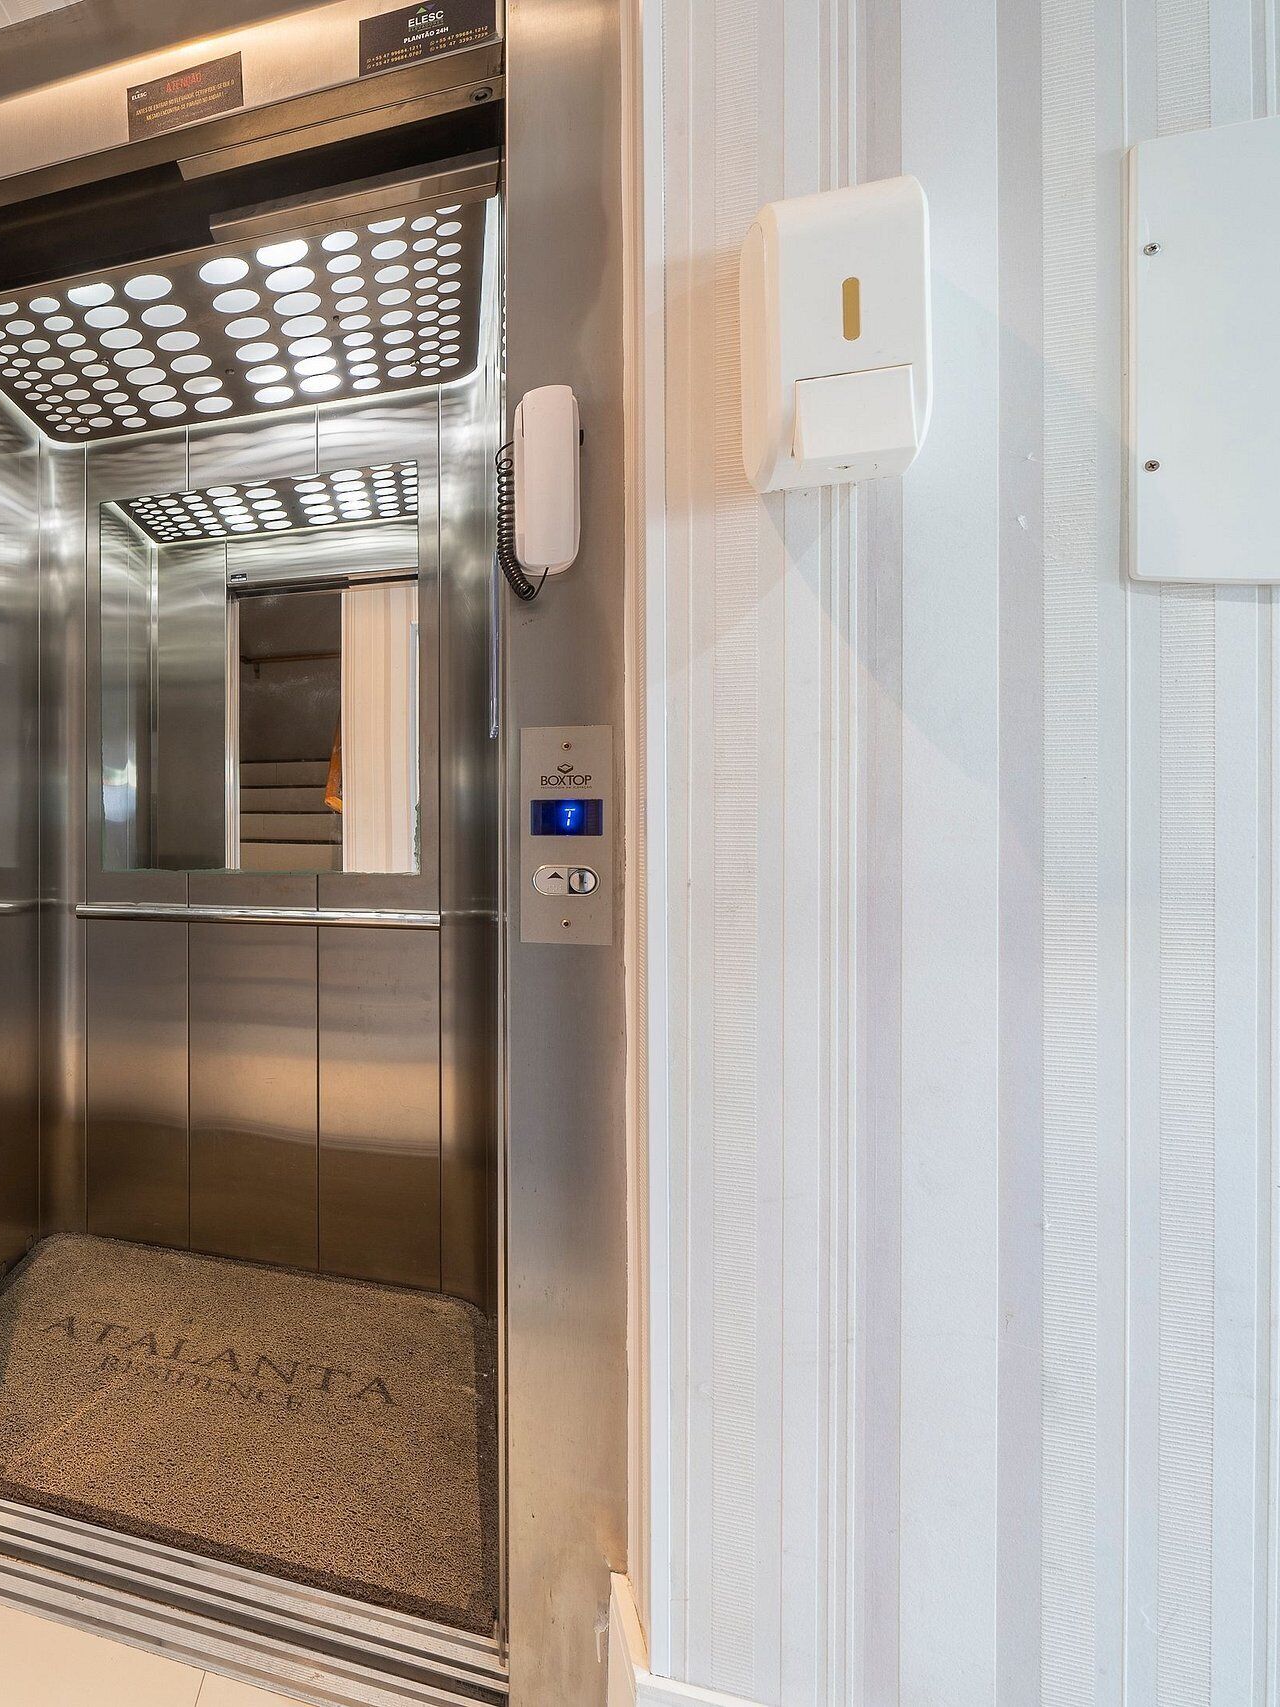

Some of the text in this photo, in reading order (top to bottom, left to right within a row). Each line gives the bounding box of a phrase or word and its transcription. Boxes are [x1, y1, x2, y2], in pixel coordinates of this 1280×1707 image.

[408, 10, 444, 27] ELESC
[403, 30, 435, 44] PLANTÃO
[435, 26, 449, 35] 24H
[131, 91, 148, 101] ELESC
[540, 774, 592, 786] BOXTOP
[45, 1314, 398, 1406] ATALANTA
